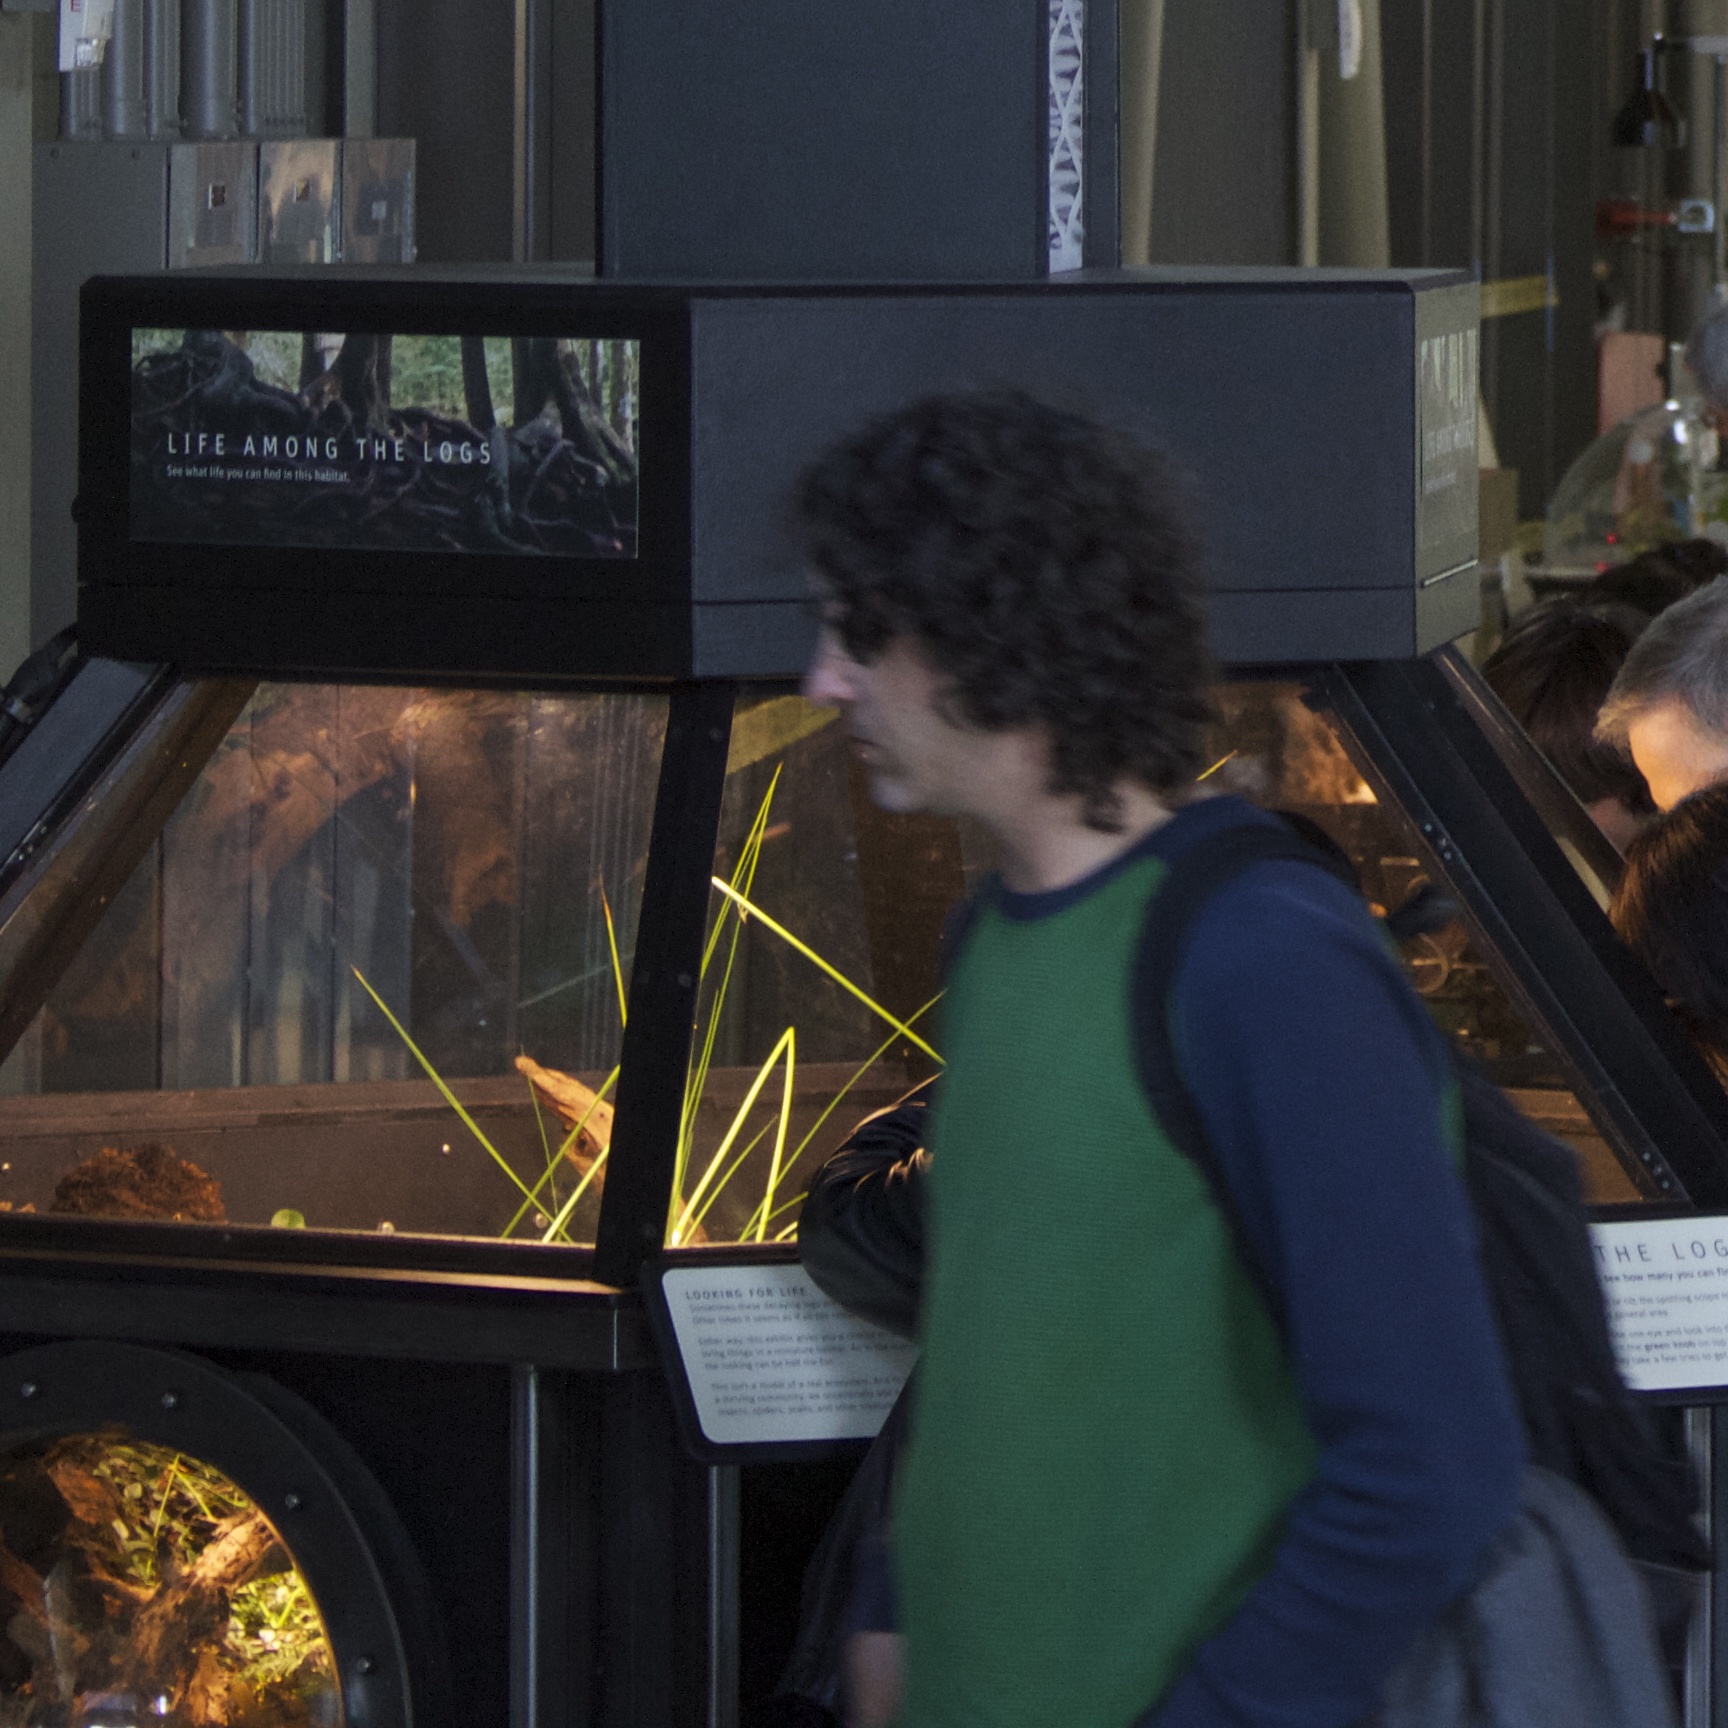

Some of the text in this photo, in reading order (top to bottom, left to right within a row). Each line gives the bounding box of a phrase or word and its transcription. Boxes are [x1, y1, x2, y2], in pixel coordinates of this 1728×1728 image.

[168, 432, 491, 465] LIFE AMONG THE LOGS
[167, 464, 184, 477] See
[185, 465, 207, 477] what
[210, 465, 224, 478] life
[226, 469, 243, 481] you
[246, 468, 261, 479] can
[295, 469, 312, 481] this
[1593, 1242, 1651, 1262] THE
[1623, 1272, 1644, 1282] how
[1647, 1272, 1673, 1283] many
[1676, 1271, 1694, 1283] you
[1697, 1270, 1714, 1278] can
[686, 1288, 743, 1301] LOOKING
[749, 1287, 774, 1299] FOR
